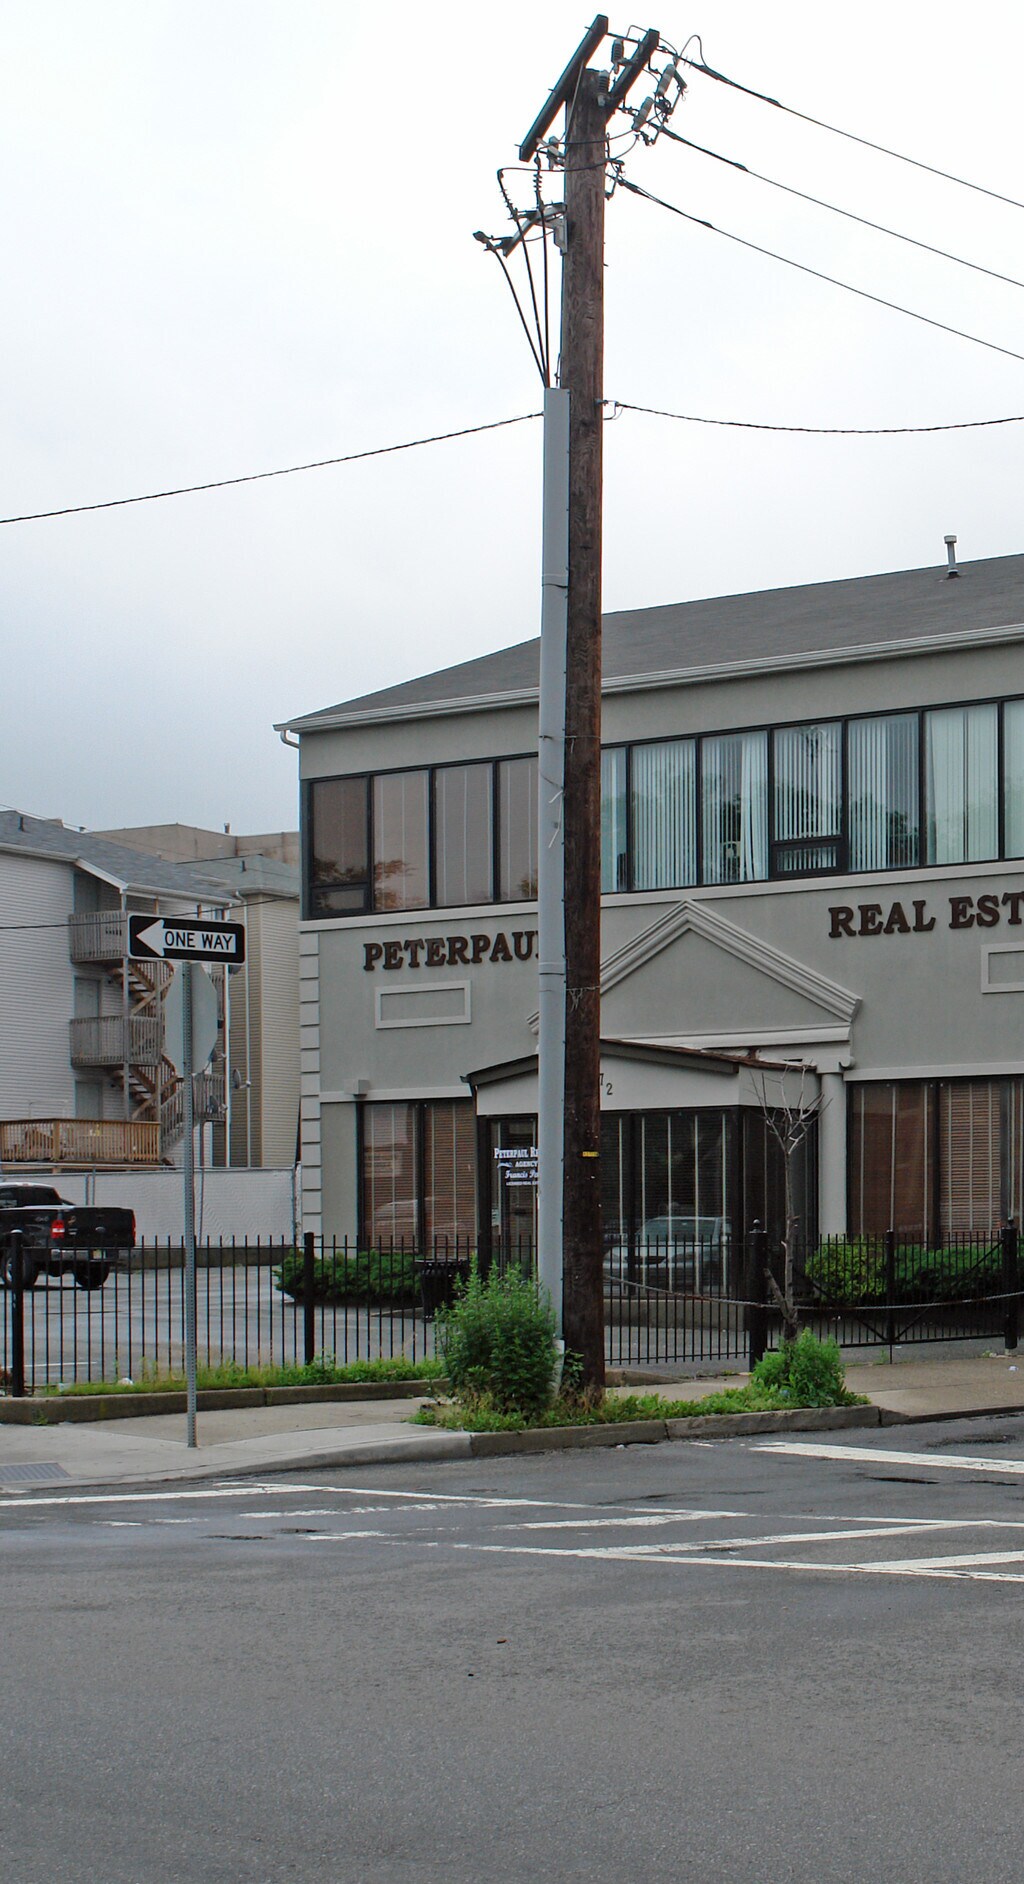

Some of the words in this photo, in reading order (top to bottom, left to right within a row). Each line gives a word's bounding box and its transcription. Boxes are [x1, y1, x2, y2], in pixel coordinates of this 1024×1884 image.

[828, 899, 936, 938] REAL
[165, 931, 195, 948] ONE
[202, 933, 233, 951] WAY
[363, 931, 538, 972] PETERPAU
